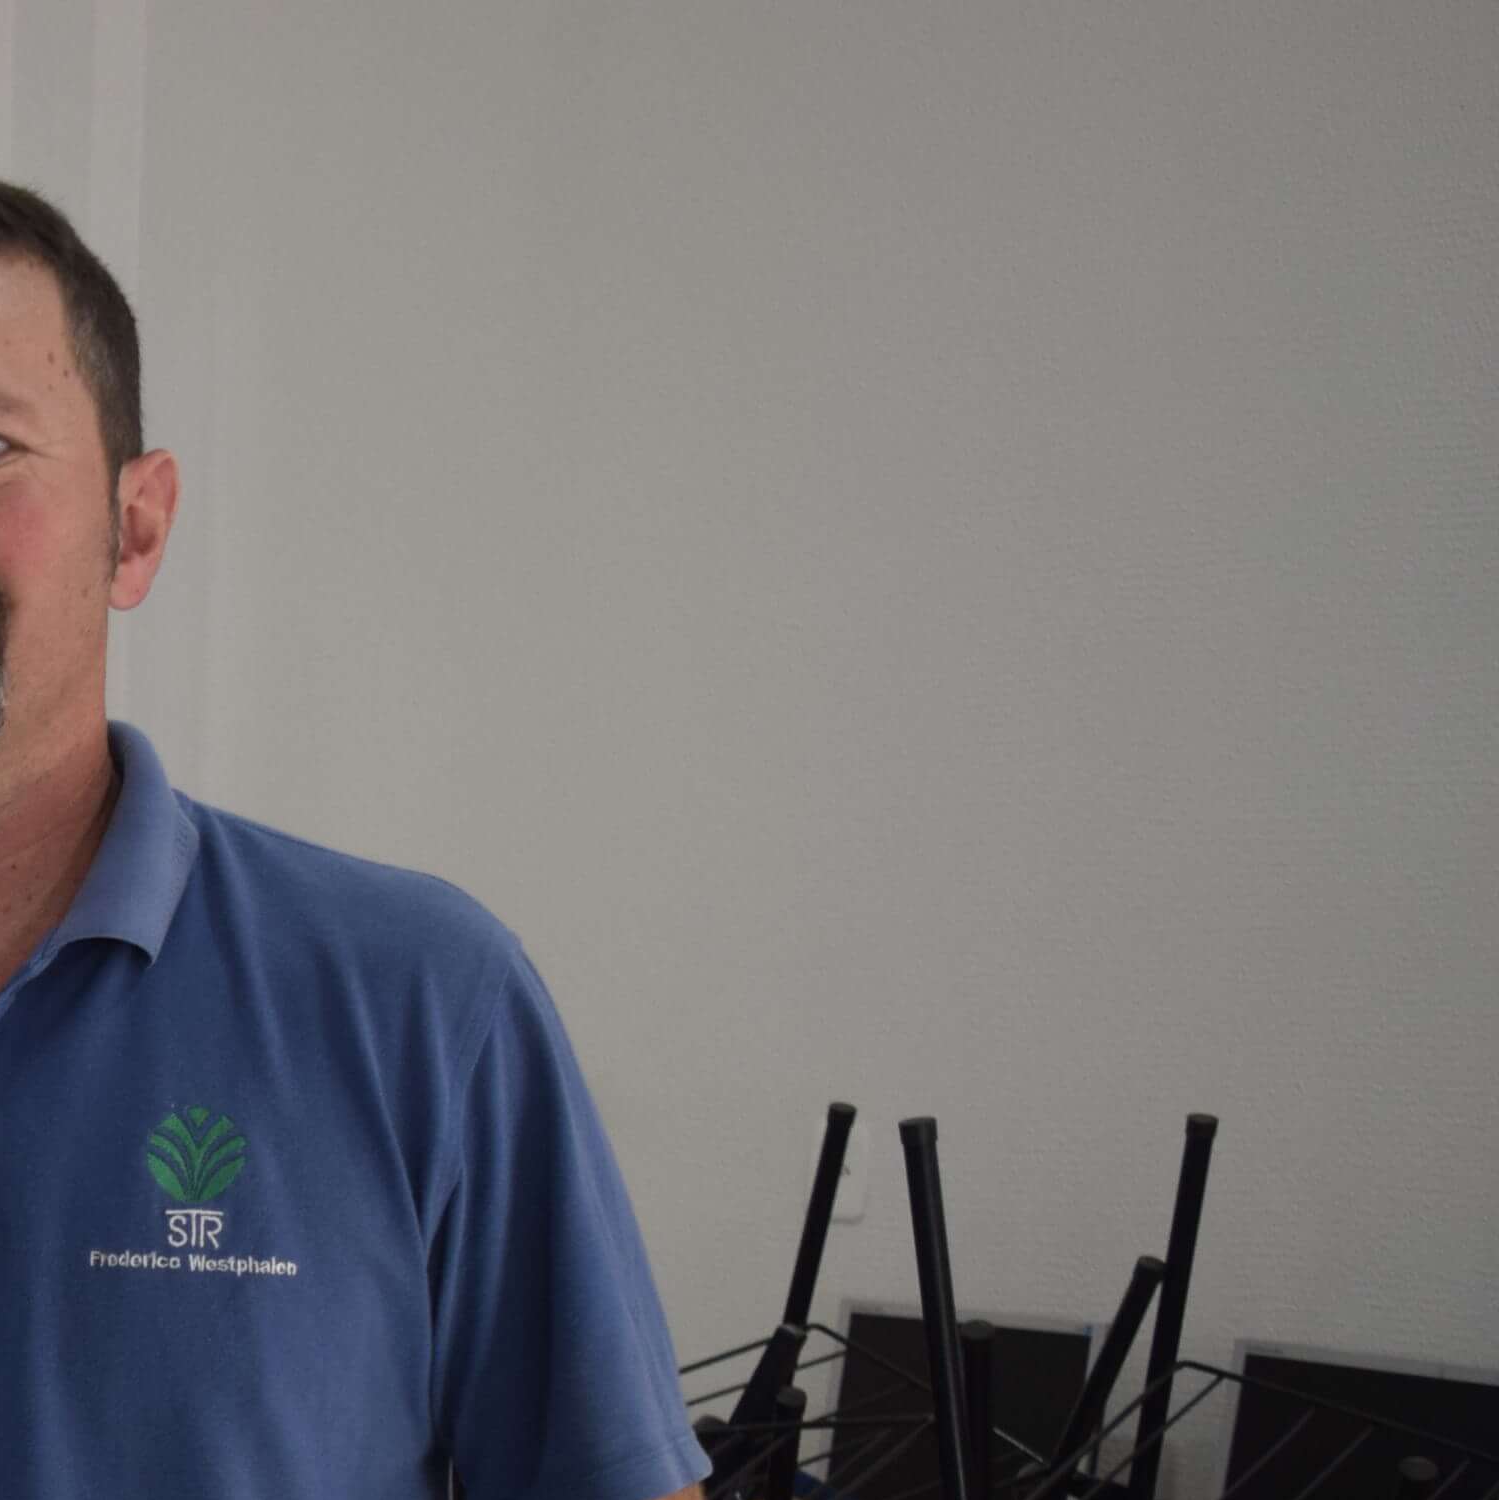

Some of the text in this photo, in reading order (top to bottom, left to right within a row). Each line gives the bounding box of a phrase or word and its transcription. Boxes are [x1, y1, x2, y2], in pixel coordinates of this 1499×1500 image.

[165, 1209, 224, 1249] STR
[89, 1250, 297, 1277] Frederico Westphalen
